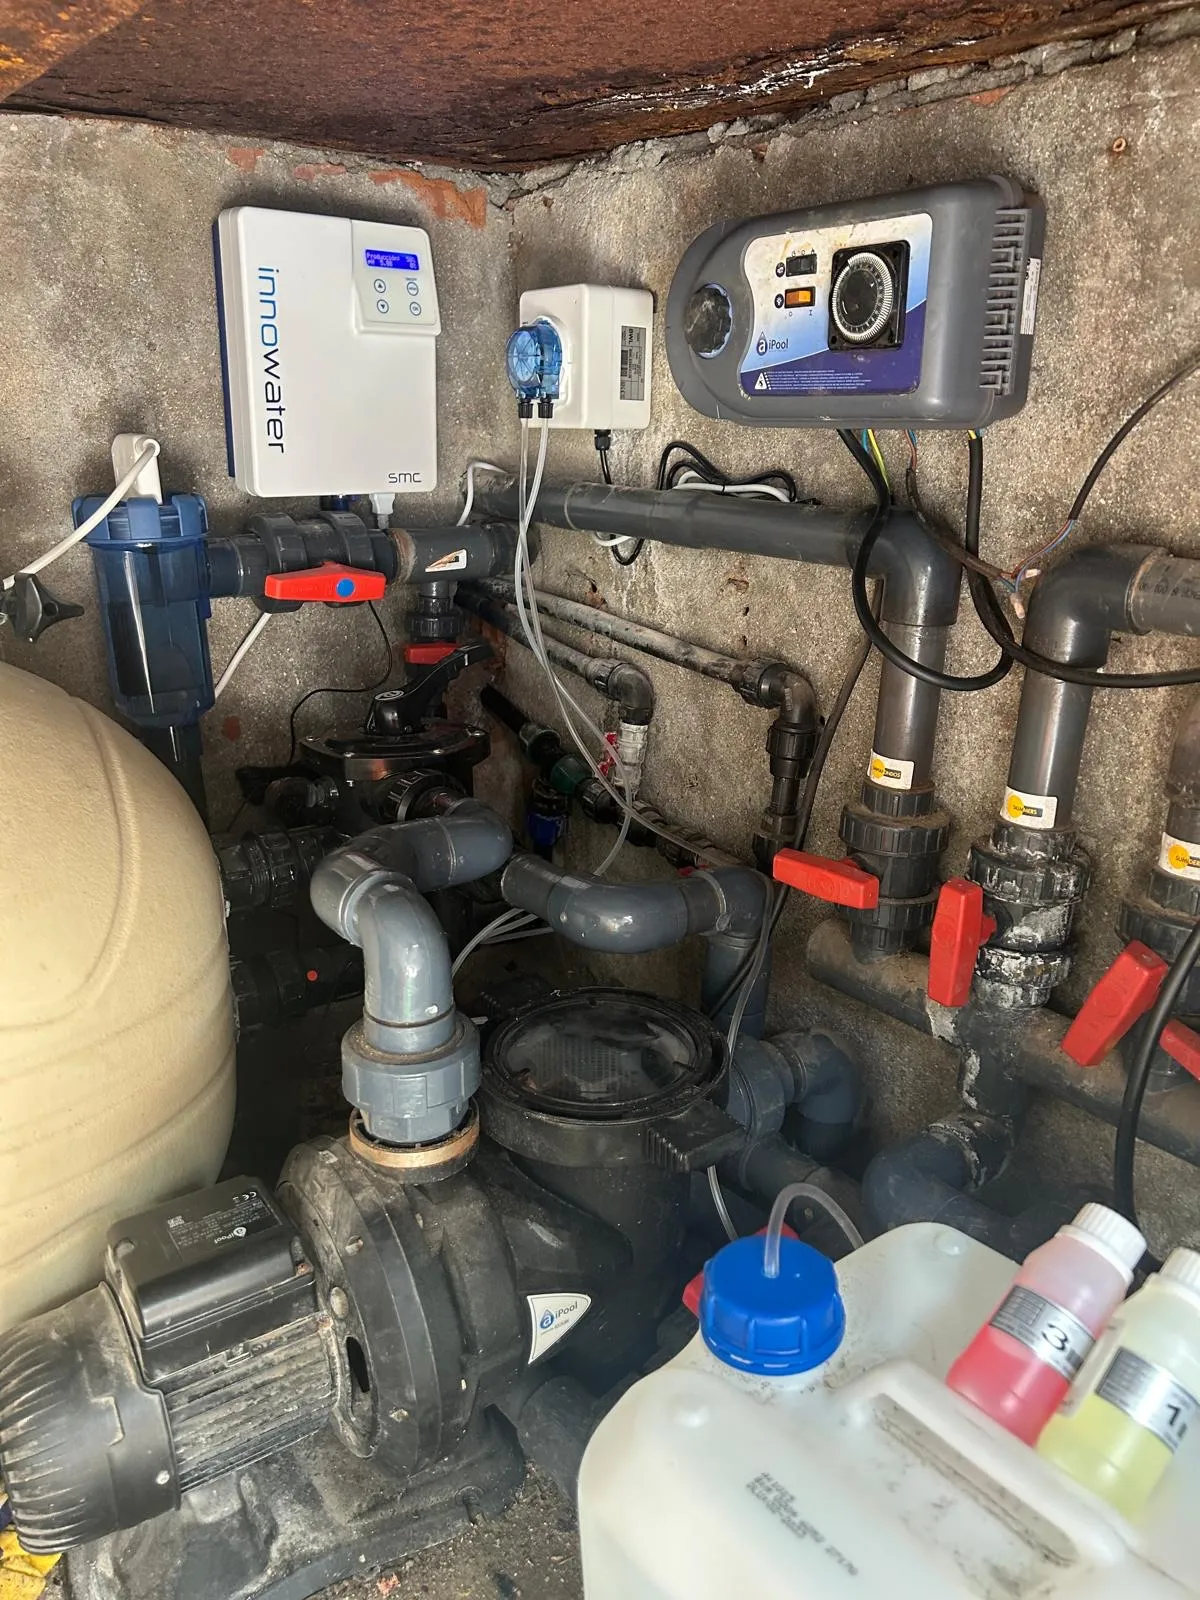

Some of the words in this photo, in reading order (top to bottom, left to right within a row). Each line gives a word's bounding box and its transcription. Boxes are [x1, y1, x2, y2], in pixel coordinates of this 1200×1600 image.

[768, 338, 789, 350] iPool
[258, 267, 285, 454] innowater
[388, 472, 422, 483] smc
[555, 1300, 578, 1318] iPool
[1041, 1322, 1069, 1351] 3
